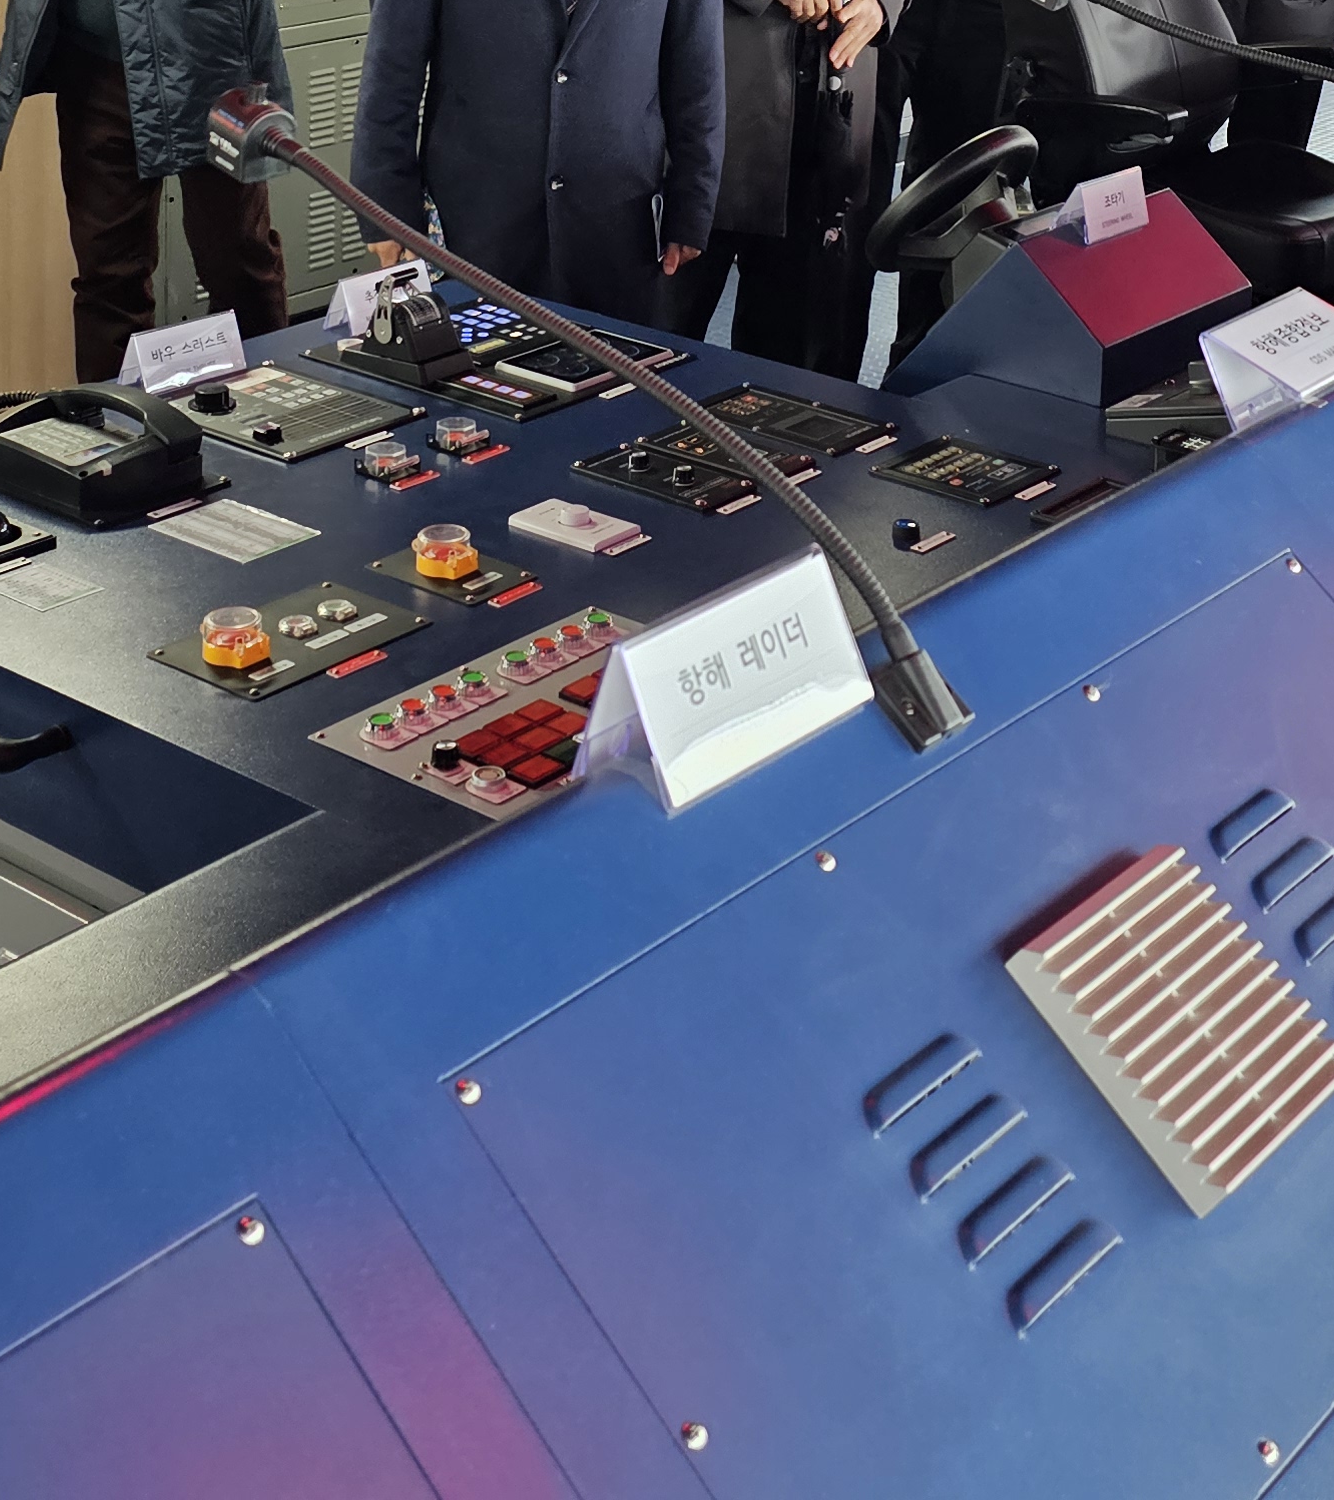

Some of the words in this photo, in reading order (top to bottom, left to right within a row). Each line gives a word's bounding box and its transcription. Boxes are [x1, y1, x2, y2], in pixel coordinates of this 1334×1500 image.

[150, 344, 176, 363] 바우
[677, 651, 732, 706] 항해
[736, 611, 809, 671] 레이더
